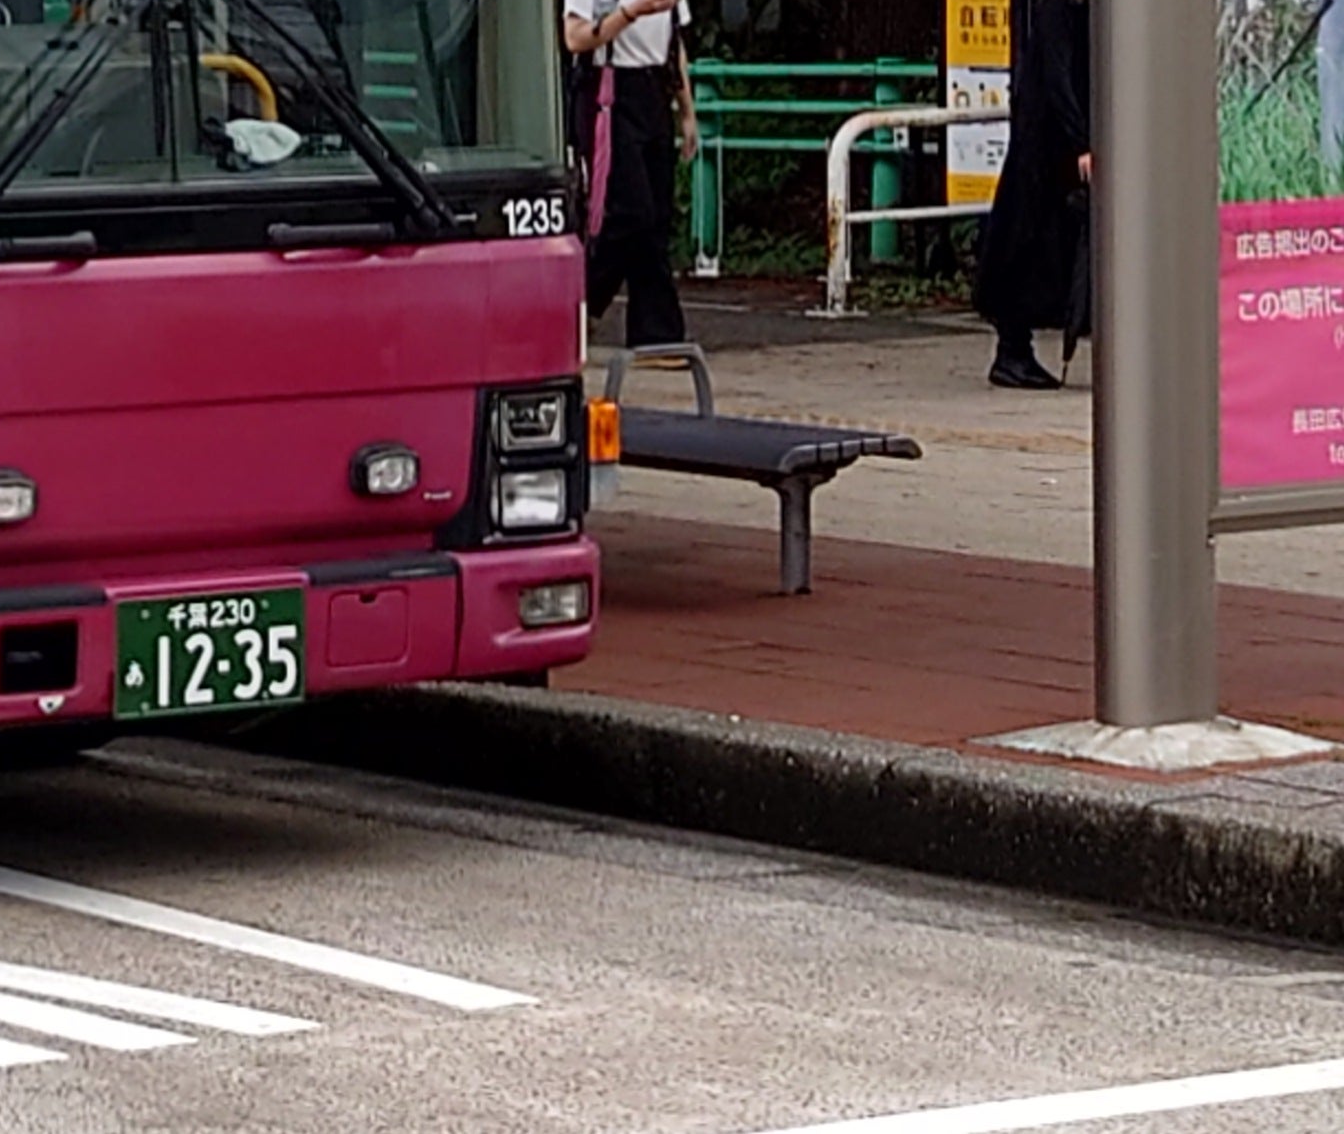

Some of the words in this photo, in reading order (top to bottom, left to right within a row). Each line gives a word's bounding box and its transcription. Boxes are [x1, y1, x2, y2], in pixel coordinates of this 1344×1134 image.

[959, 4, 1008, 29] 自転
[501, 197, 566, 237] 1235
[1238, 286, 1344, 321] この場所に
